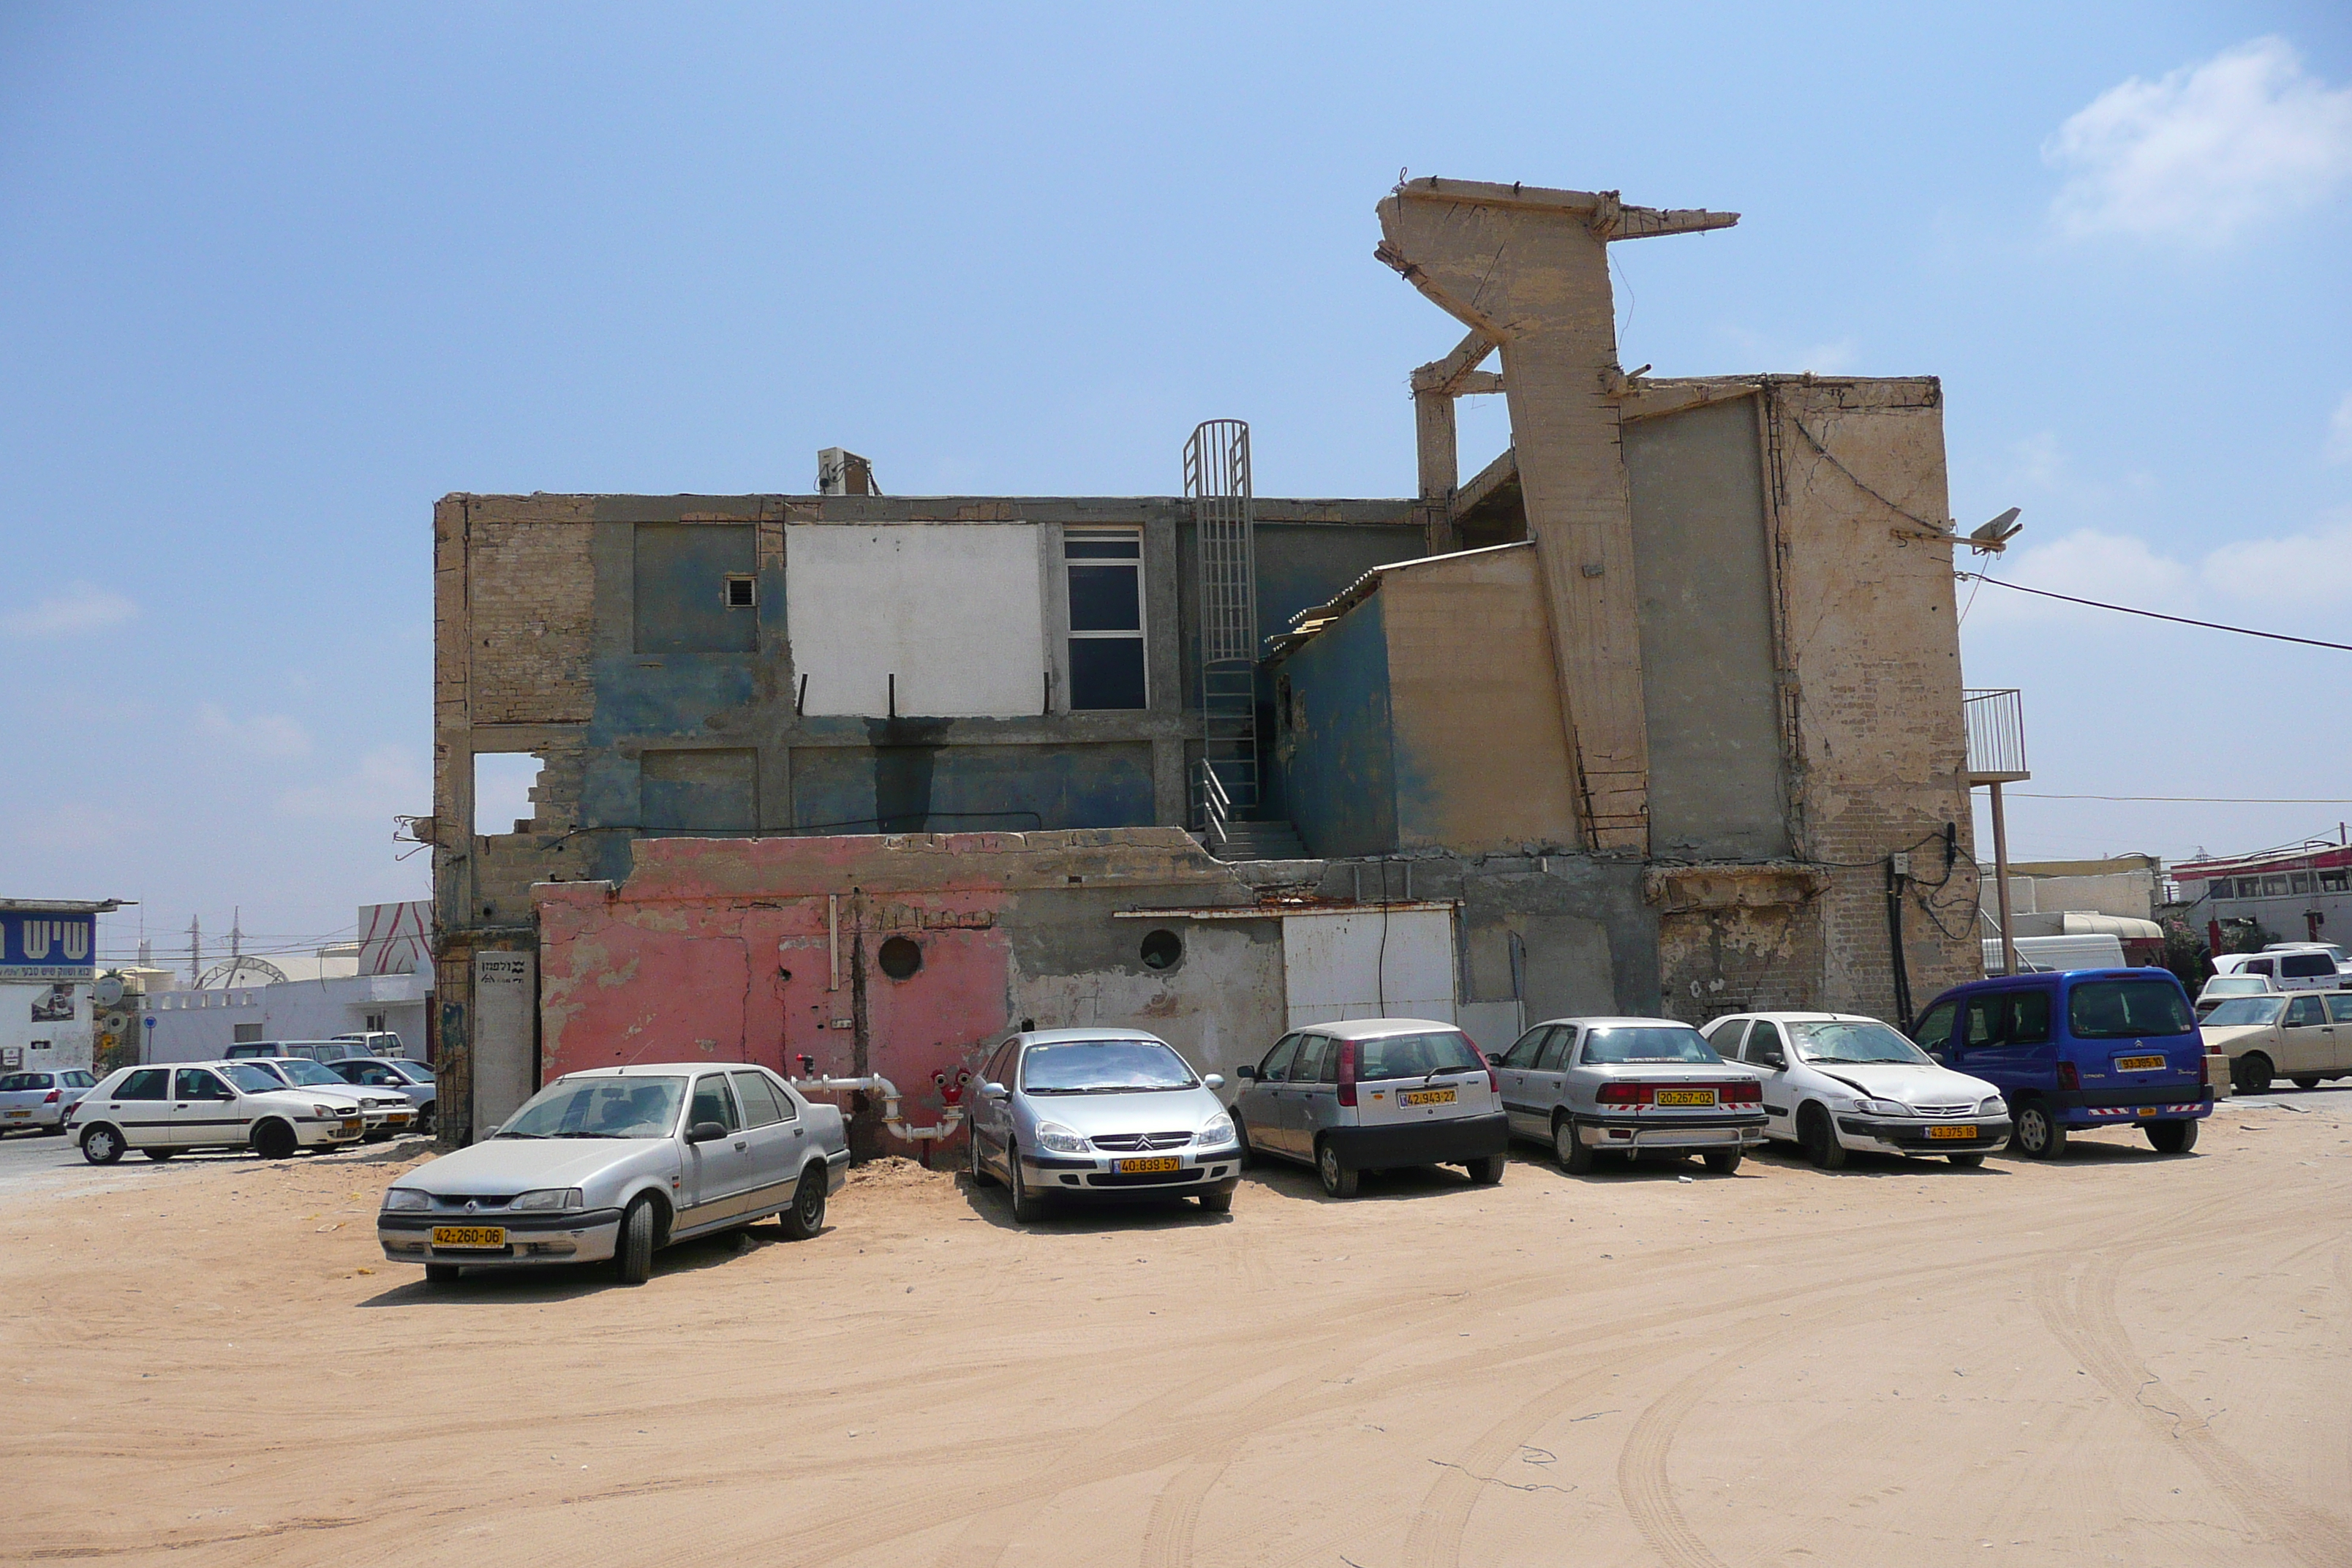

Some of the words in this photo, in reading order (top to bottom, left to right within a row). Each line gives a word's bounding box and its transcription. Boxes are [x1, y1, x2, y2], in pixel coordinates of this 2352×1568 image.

[23, 920, 88, 960] שיש
[40, 967, 56, 976] שיש
[436, 1229, 500, 1243] 42-260-06
